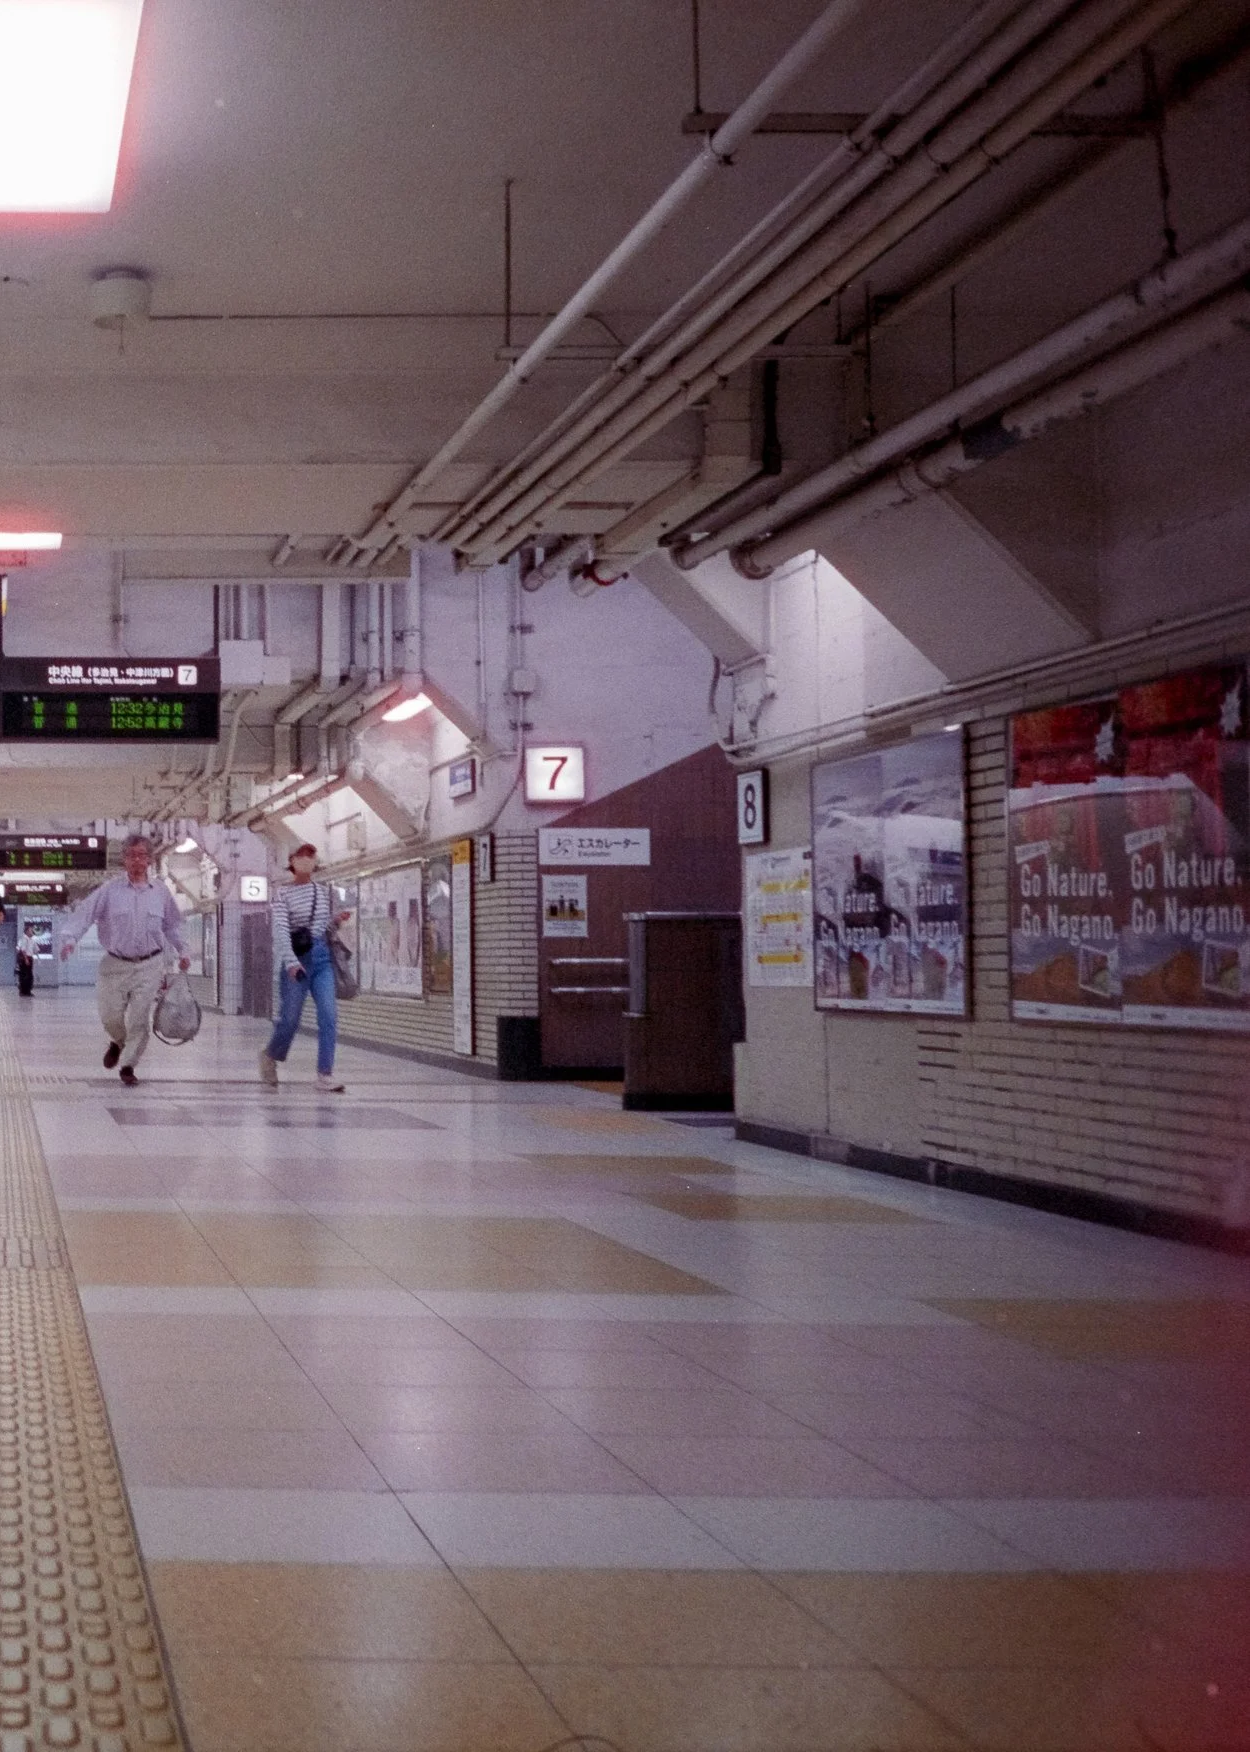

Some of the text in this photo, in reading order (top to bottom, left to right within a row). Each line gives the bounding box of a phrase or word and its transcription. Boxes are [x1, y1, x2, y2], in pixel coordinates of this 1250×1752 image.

[110, 702, 143, 715] 12:32
[110, 716, 143, 729] 12:52
[542, 756, 568, 791] 7
[744, 783, 757, 830] 8
[577, 838, 640, 849] エスカレーター
[247, 880, 260, 896] 5
[1020, 863, 1042, 897] Go
[1131, 853, 1156, 891] Go
[1020, 903, 1042, 937] Go
[1131, 898, 1157, 935] Go
